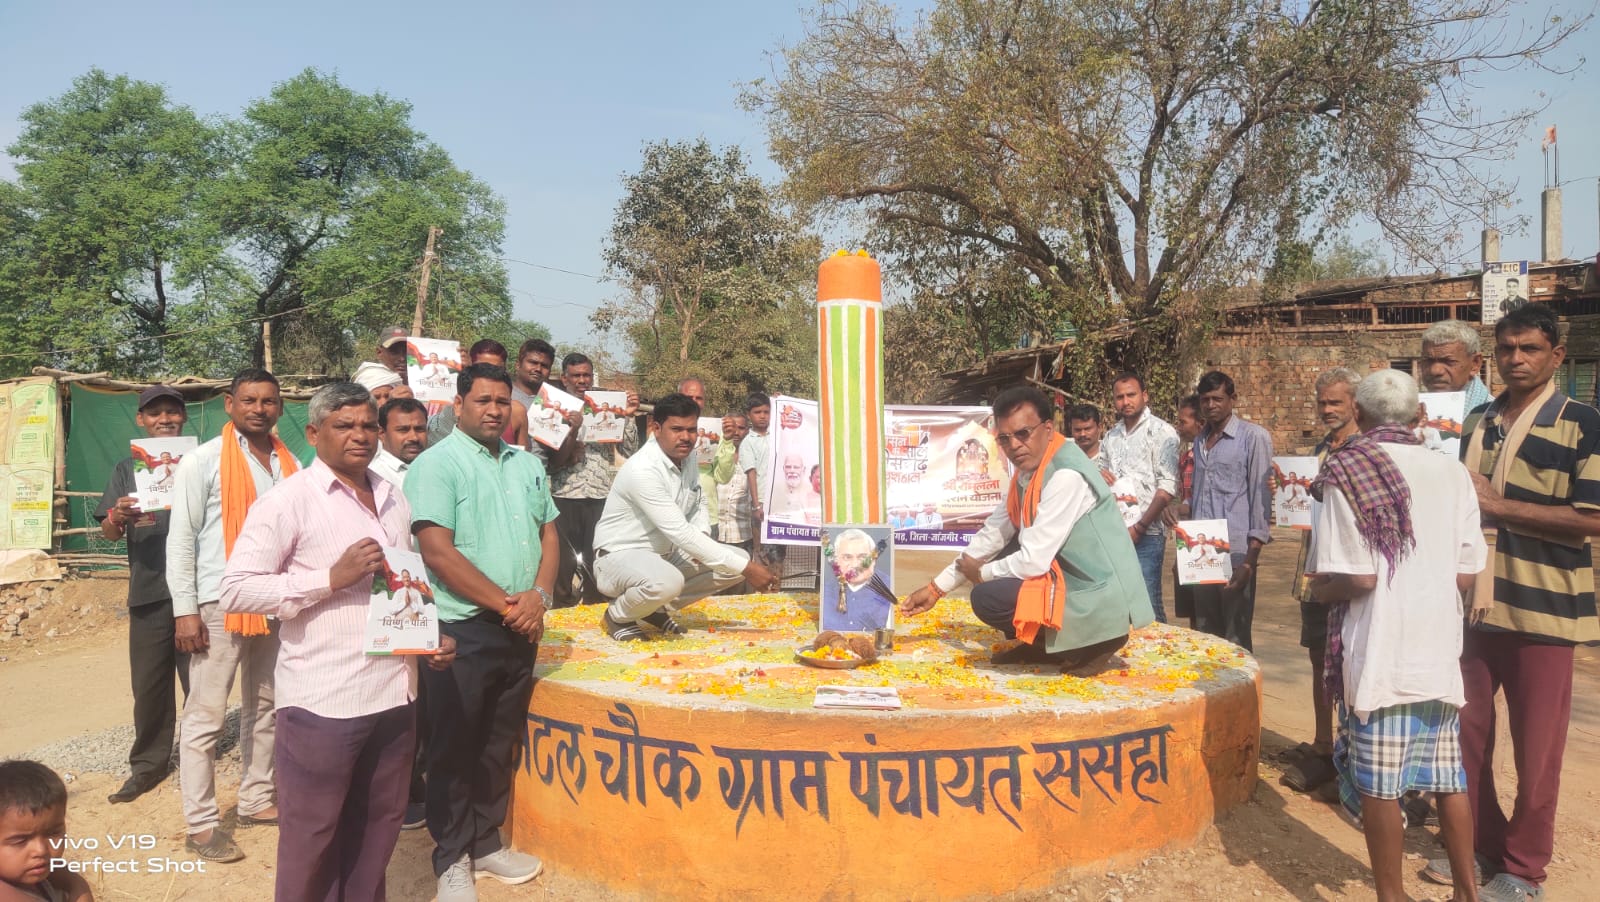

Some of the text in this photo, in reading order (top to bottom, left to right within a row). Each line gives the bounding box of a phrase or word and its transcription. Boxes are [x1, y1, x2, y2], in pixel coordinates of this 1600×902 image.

[592, 702, 705, 809] चौक
[711, 745, 840, 840] ग्राम
[838, 734, 1031, 833] पंचायत
[1031, 723, 1176, 813] ससहा
